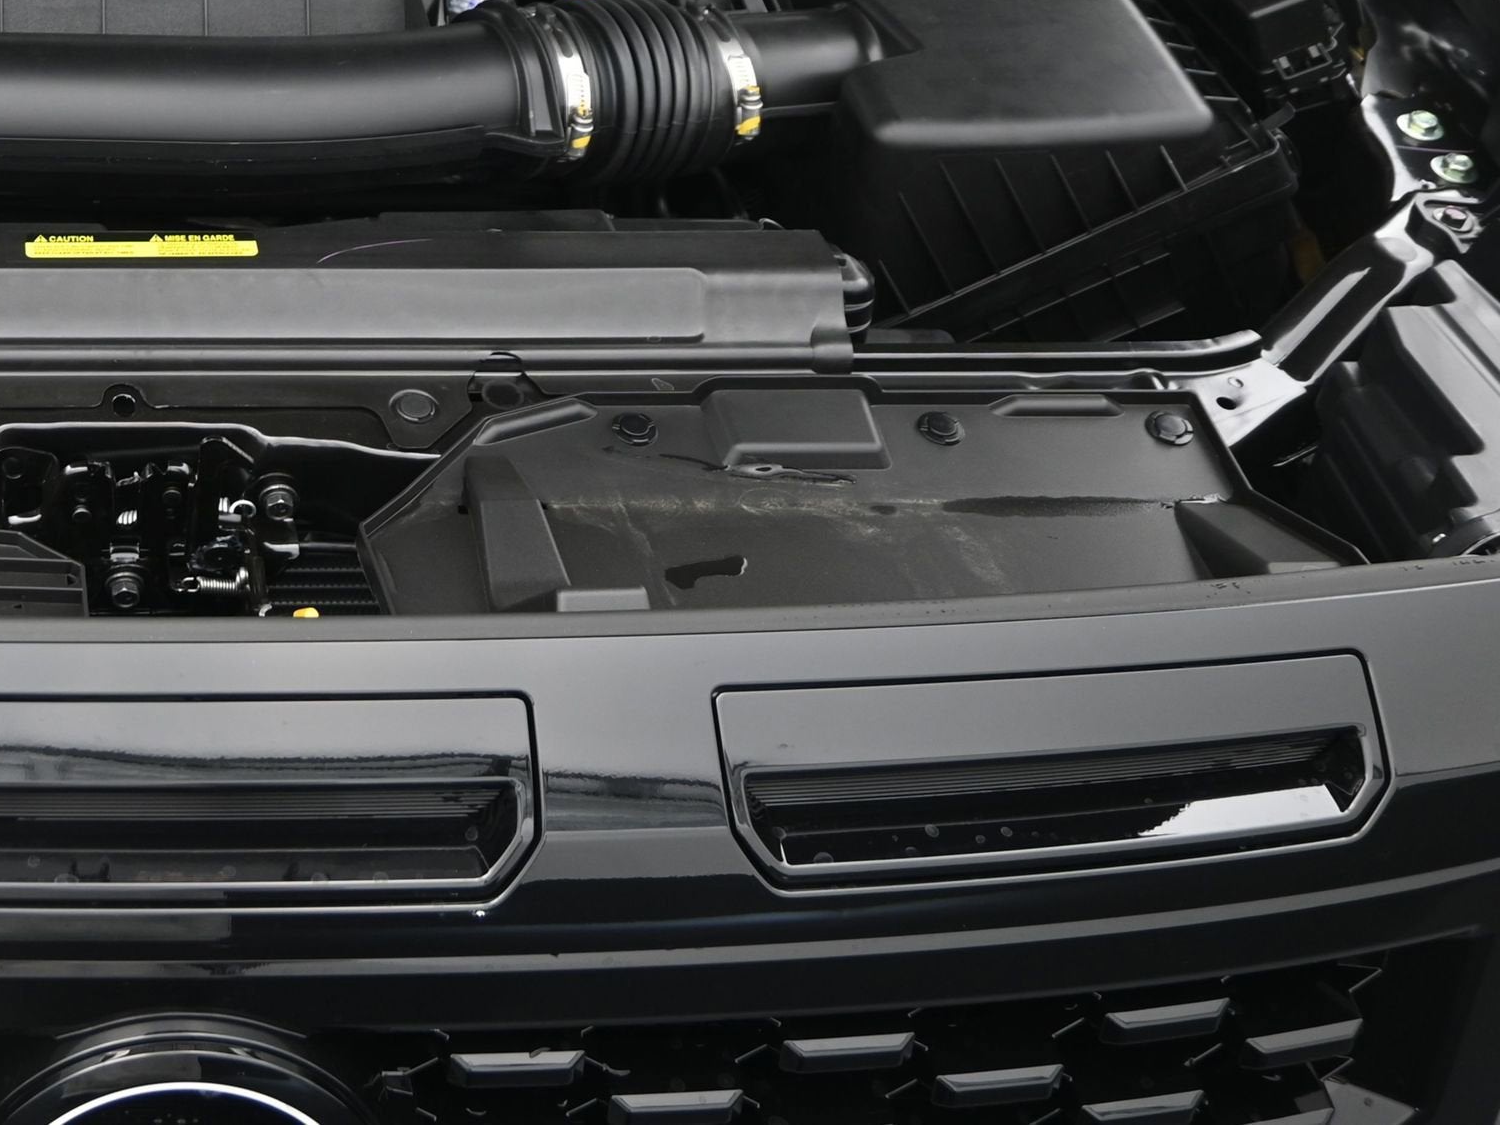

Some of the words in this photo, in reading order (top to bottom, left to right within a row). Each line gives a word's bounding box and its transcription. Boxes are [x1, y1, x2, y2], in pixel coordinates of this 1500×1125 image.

[48, 235, 94, 243] CAUTION
[188, 234, 201, 242] EN
[202, 234, 235, 242] GARDE
